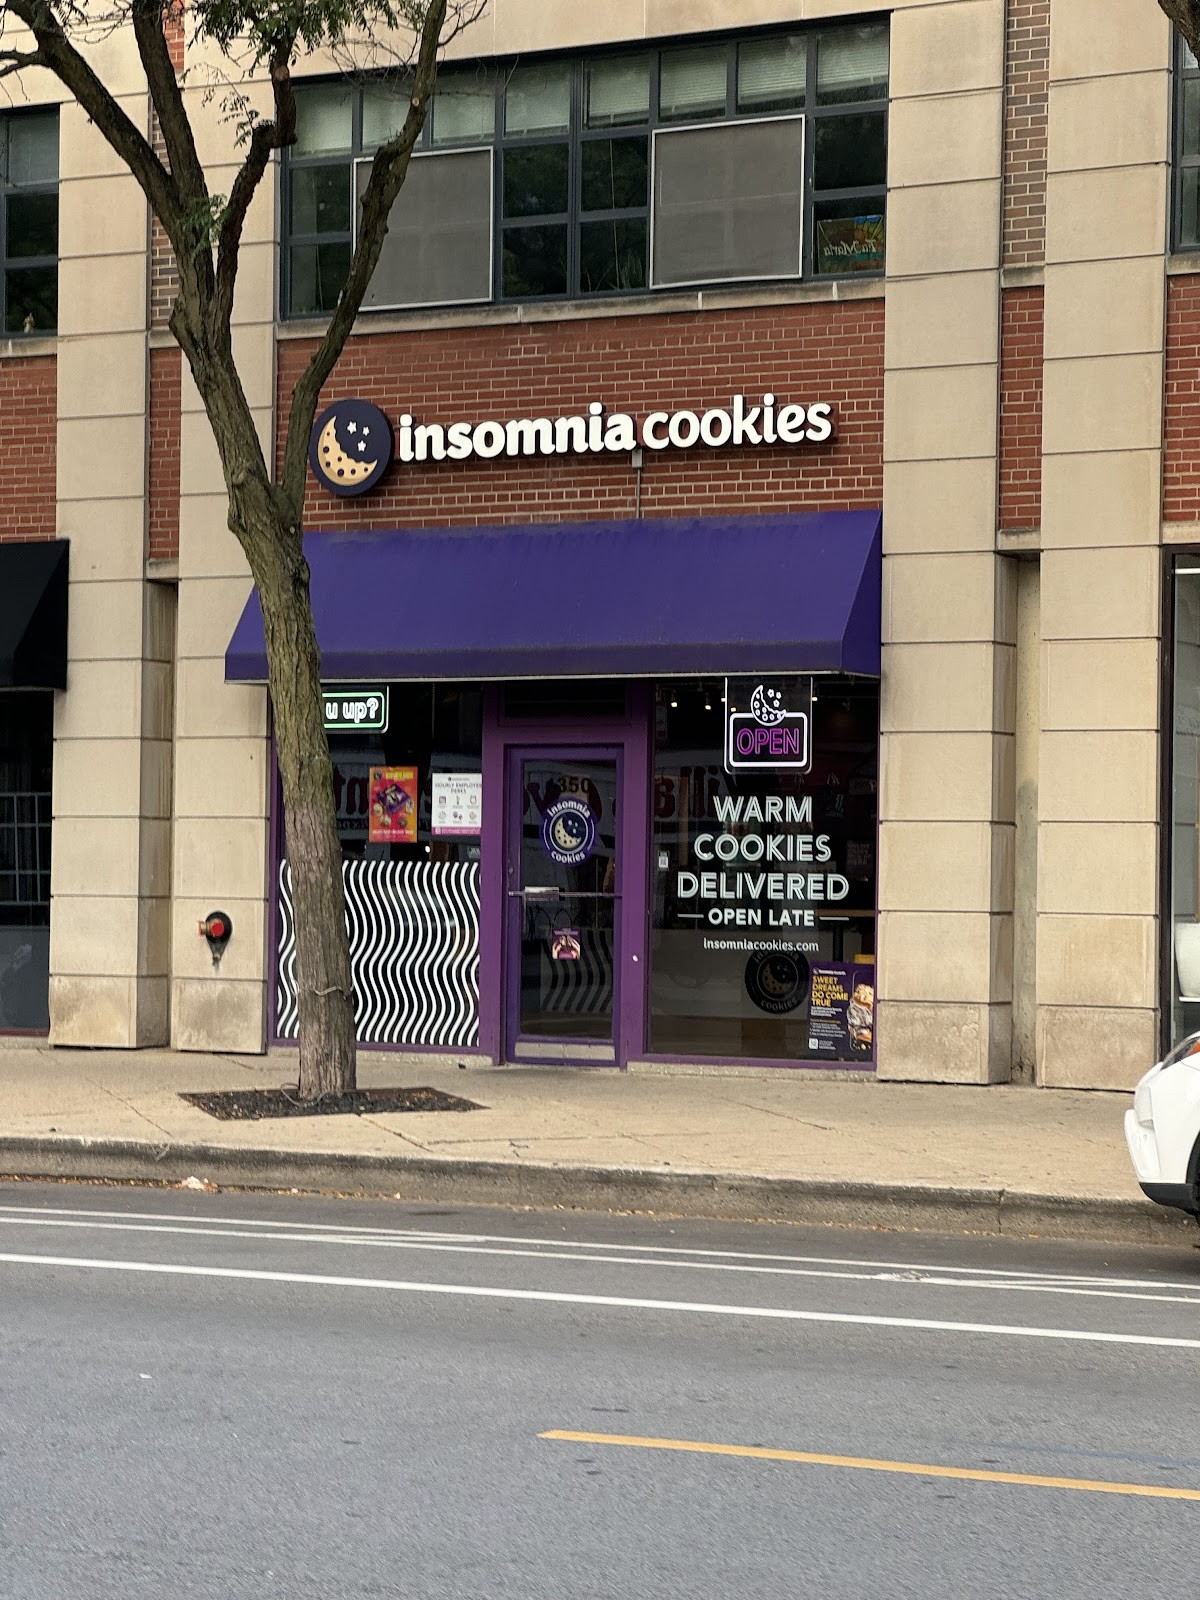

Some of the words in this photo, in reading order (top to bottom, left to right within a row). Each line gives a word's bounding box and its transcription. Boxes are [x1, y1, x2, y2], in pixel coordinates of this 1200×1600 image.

[399, 401, 637, 462] insomnia
[642, 392, 832, 450] cookies
[325, 702, 338, 720] u
[342, 697, 379, 723] up?
[737, 728, 800, 755] OPEN
[558, 776, 590, 793] 350
[713, 795, 813, 823] WARM
[551, 849, 585, 864] cookies
[694, 834, 832, 862] COOKIES
[677, 871, 849, 901] DELIVERED
[708, 908, 762, 926] OPEN
[769, 909, 815, 927] LATE
[812, 976, 838, 984] SWEET
[812, 984, 843, 993] DREAMS
[811, 991, 825, 999] DO
[826, 992, 848, 1001] COME
[811, 998, 831, 1007] TRUE
